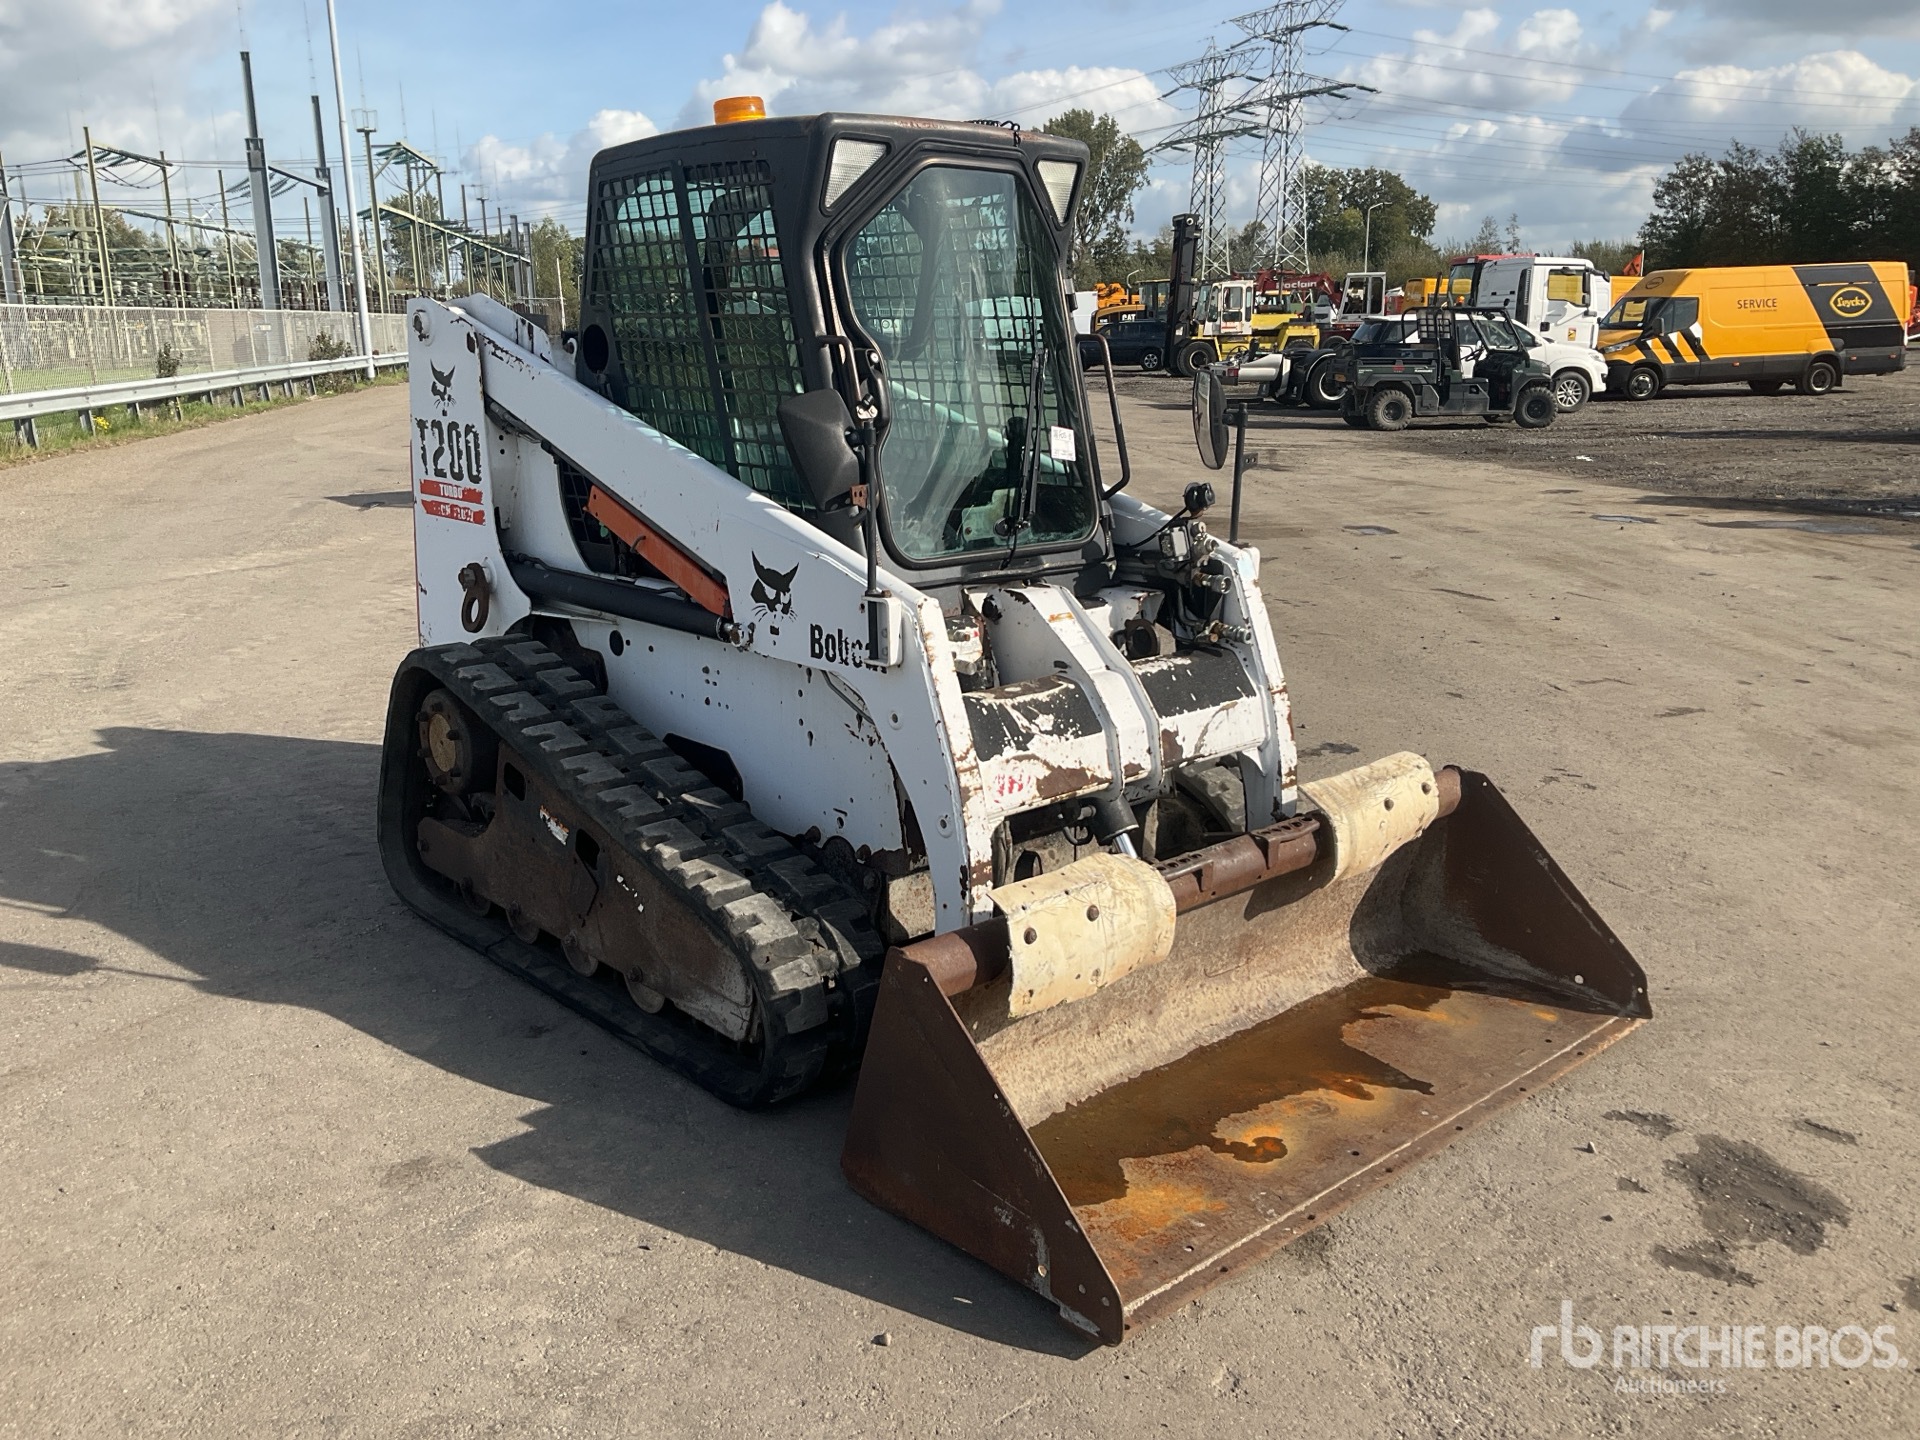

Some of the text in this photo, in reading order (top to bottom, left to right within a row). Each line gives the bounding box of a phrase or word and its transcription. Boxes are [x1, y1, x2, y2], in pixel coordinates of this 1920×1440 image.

[1737, 298, 1777, 309] SERVICE
[1122, 313, 1136, 322] CAT
[415, 417, 482, 484] T200
[439, 484, 463, 499] TURBO
